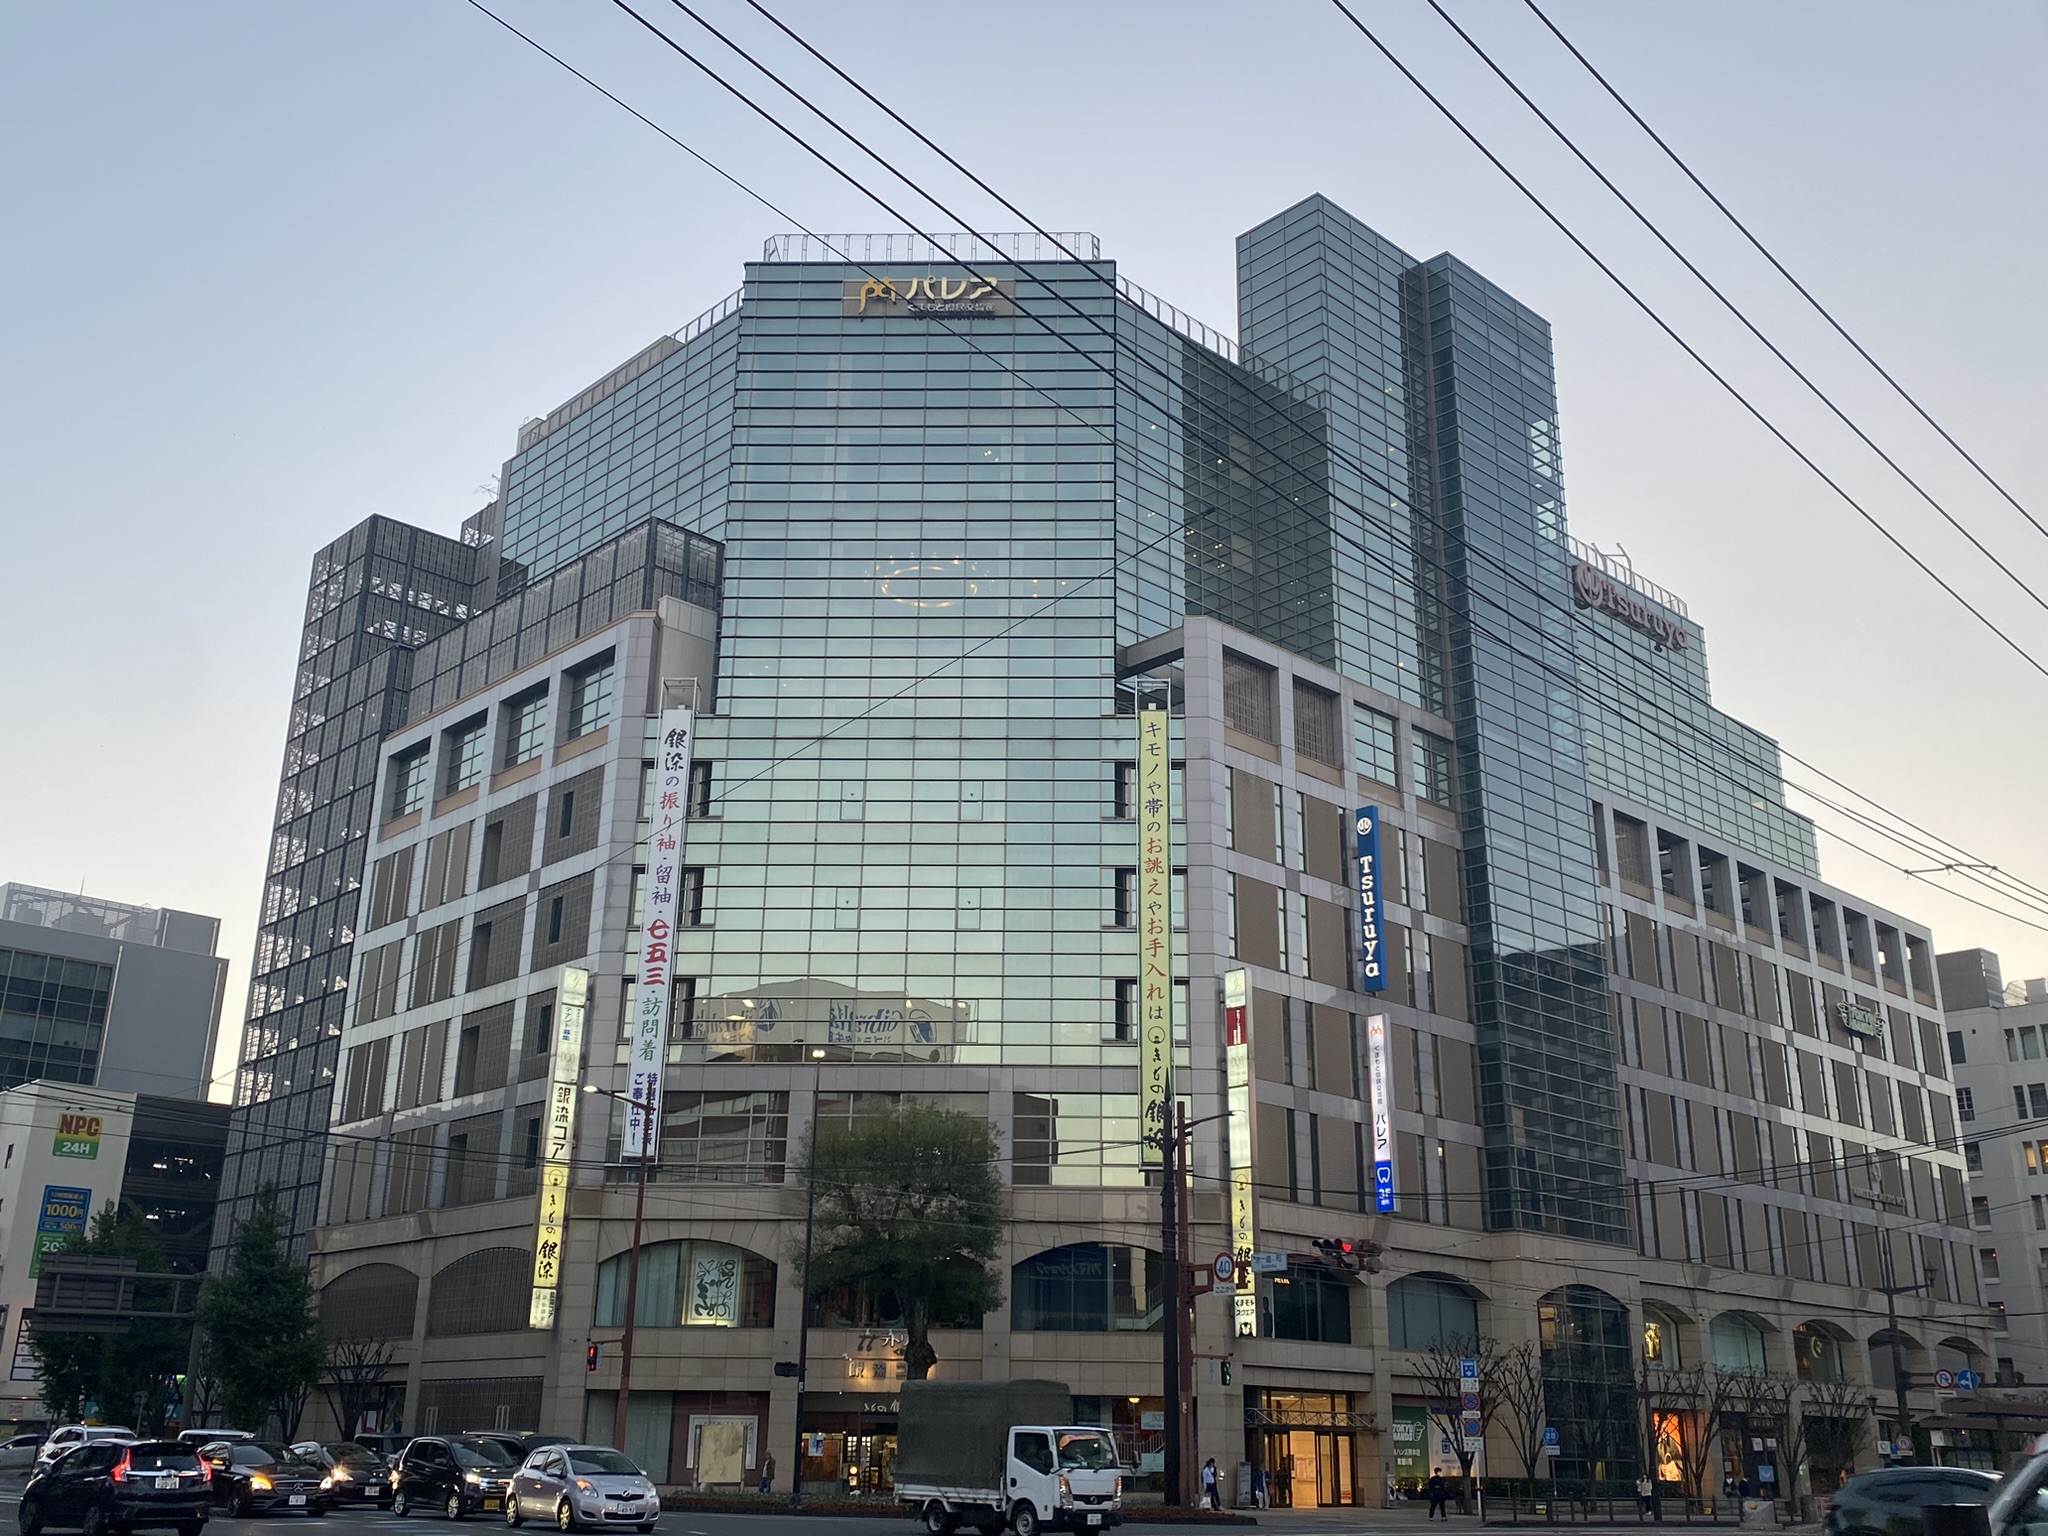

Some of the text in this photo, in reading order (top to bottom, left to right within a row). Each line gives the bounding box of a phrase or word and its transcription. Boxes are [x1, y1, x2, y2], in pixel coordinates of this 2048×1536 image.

[906, 275, 997, 301] パレア
[1600, 579, 1689, 651] Tsuruya
[1143, 721, 1167, 1020] キモノや帯のお誂えやお手入れは
[1359, 855, 1380, 978] Tsuruya
[59, 1114, 100, 1137] NPC
[1375, 1112, 1387, 1150] パレア
[61, 1141, 90, 1154] 24H
[1218, 1260, 1231, 1274] 40
[1215, 1286, 1235, 1294] ここから
[1235, 1309, 1255, 1317] スクエア
